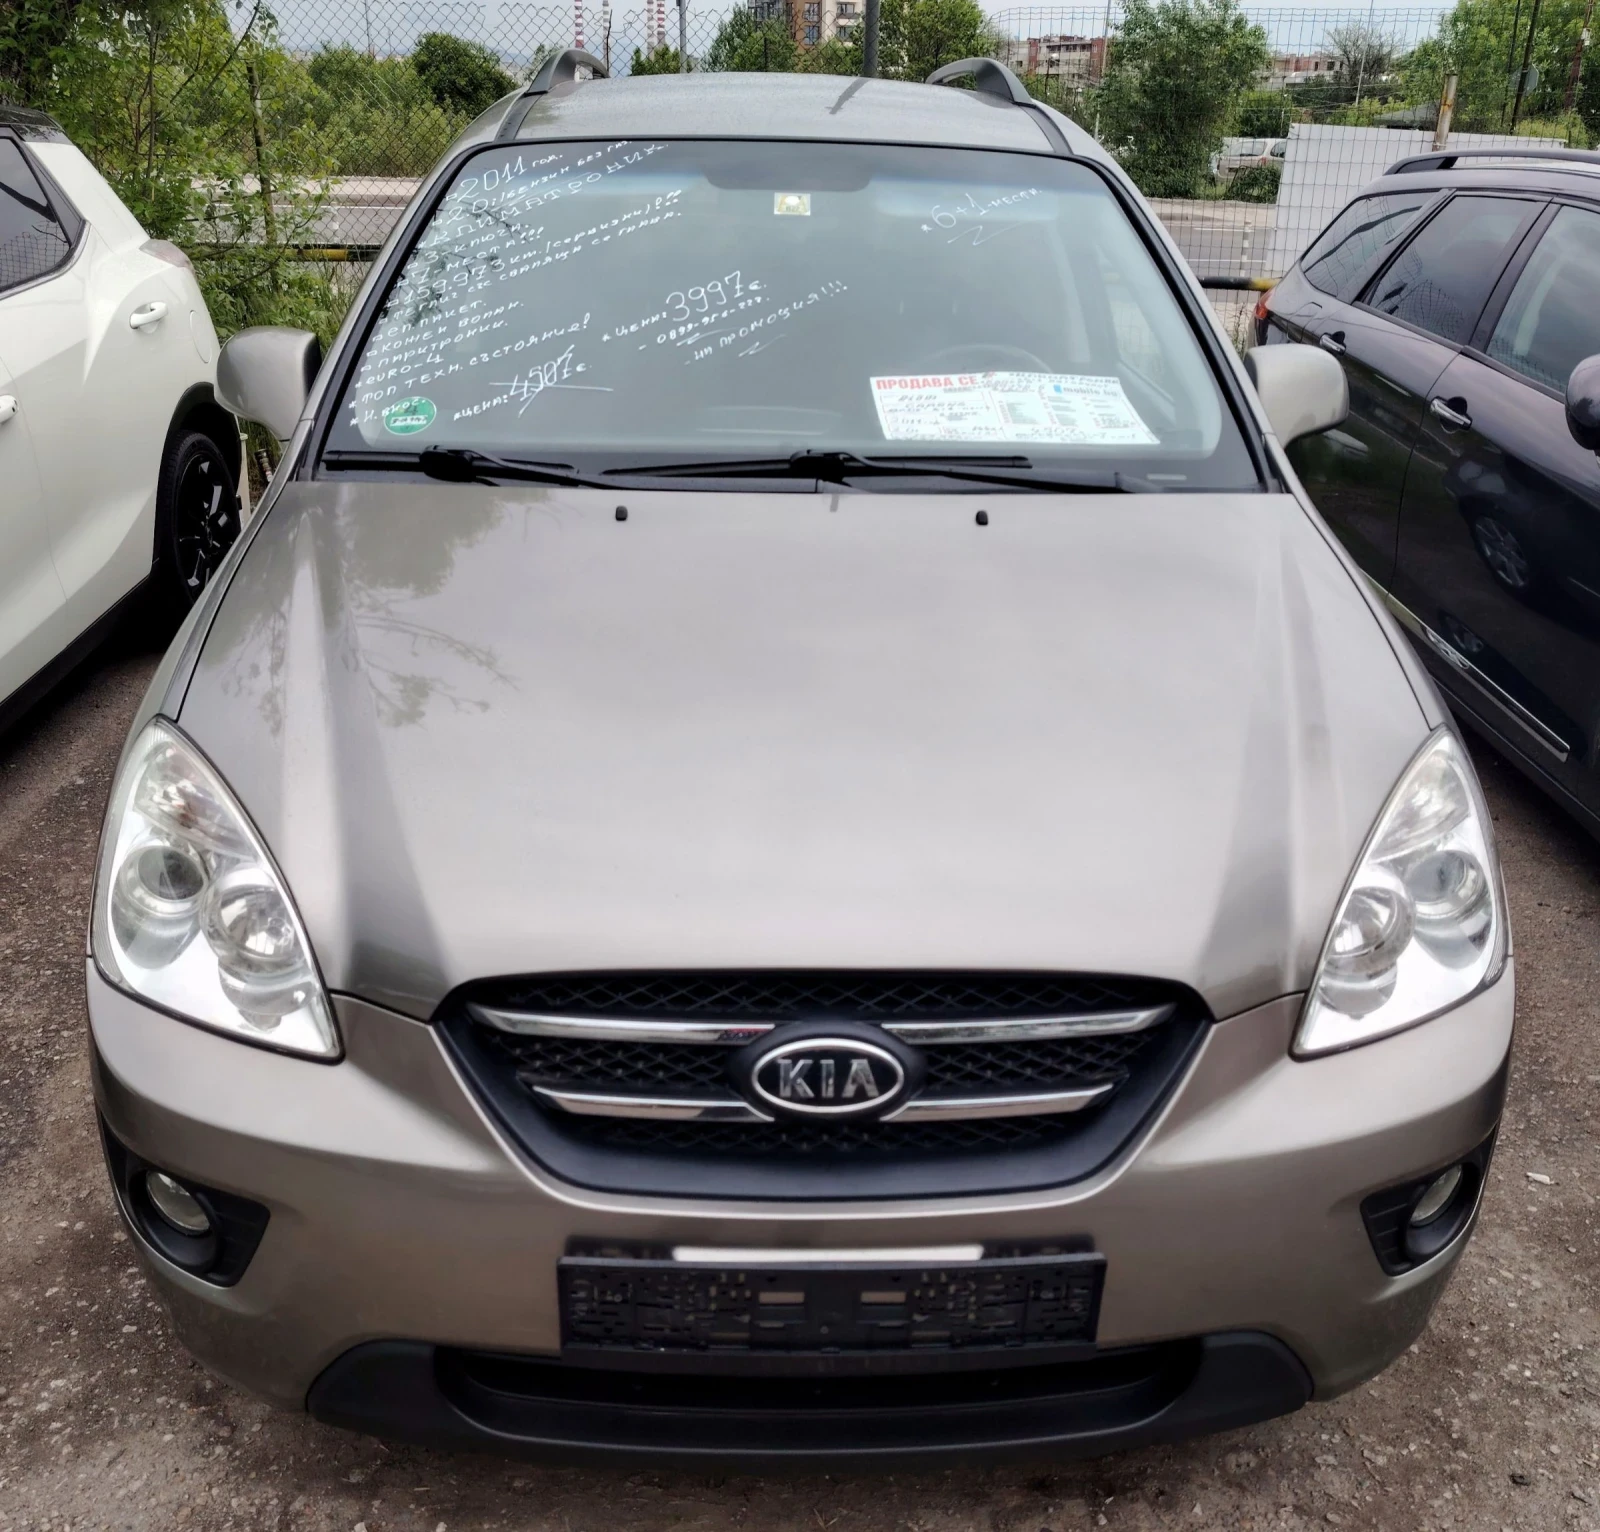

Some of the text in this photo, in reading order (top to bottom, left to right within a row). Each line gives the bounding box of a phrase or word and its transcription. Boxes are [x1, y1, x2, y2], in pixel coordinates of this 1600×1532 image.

[457, 155, 528, 203] 2011
[876, 377, 954, 390] ПРОДАВА
[958, 375, 979, 386] СЕ
[777, 1059, 880, 1098] KIA
